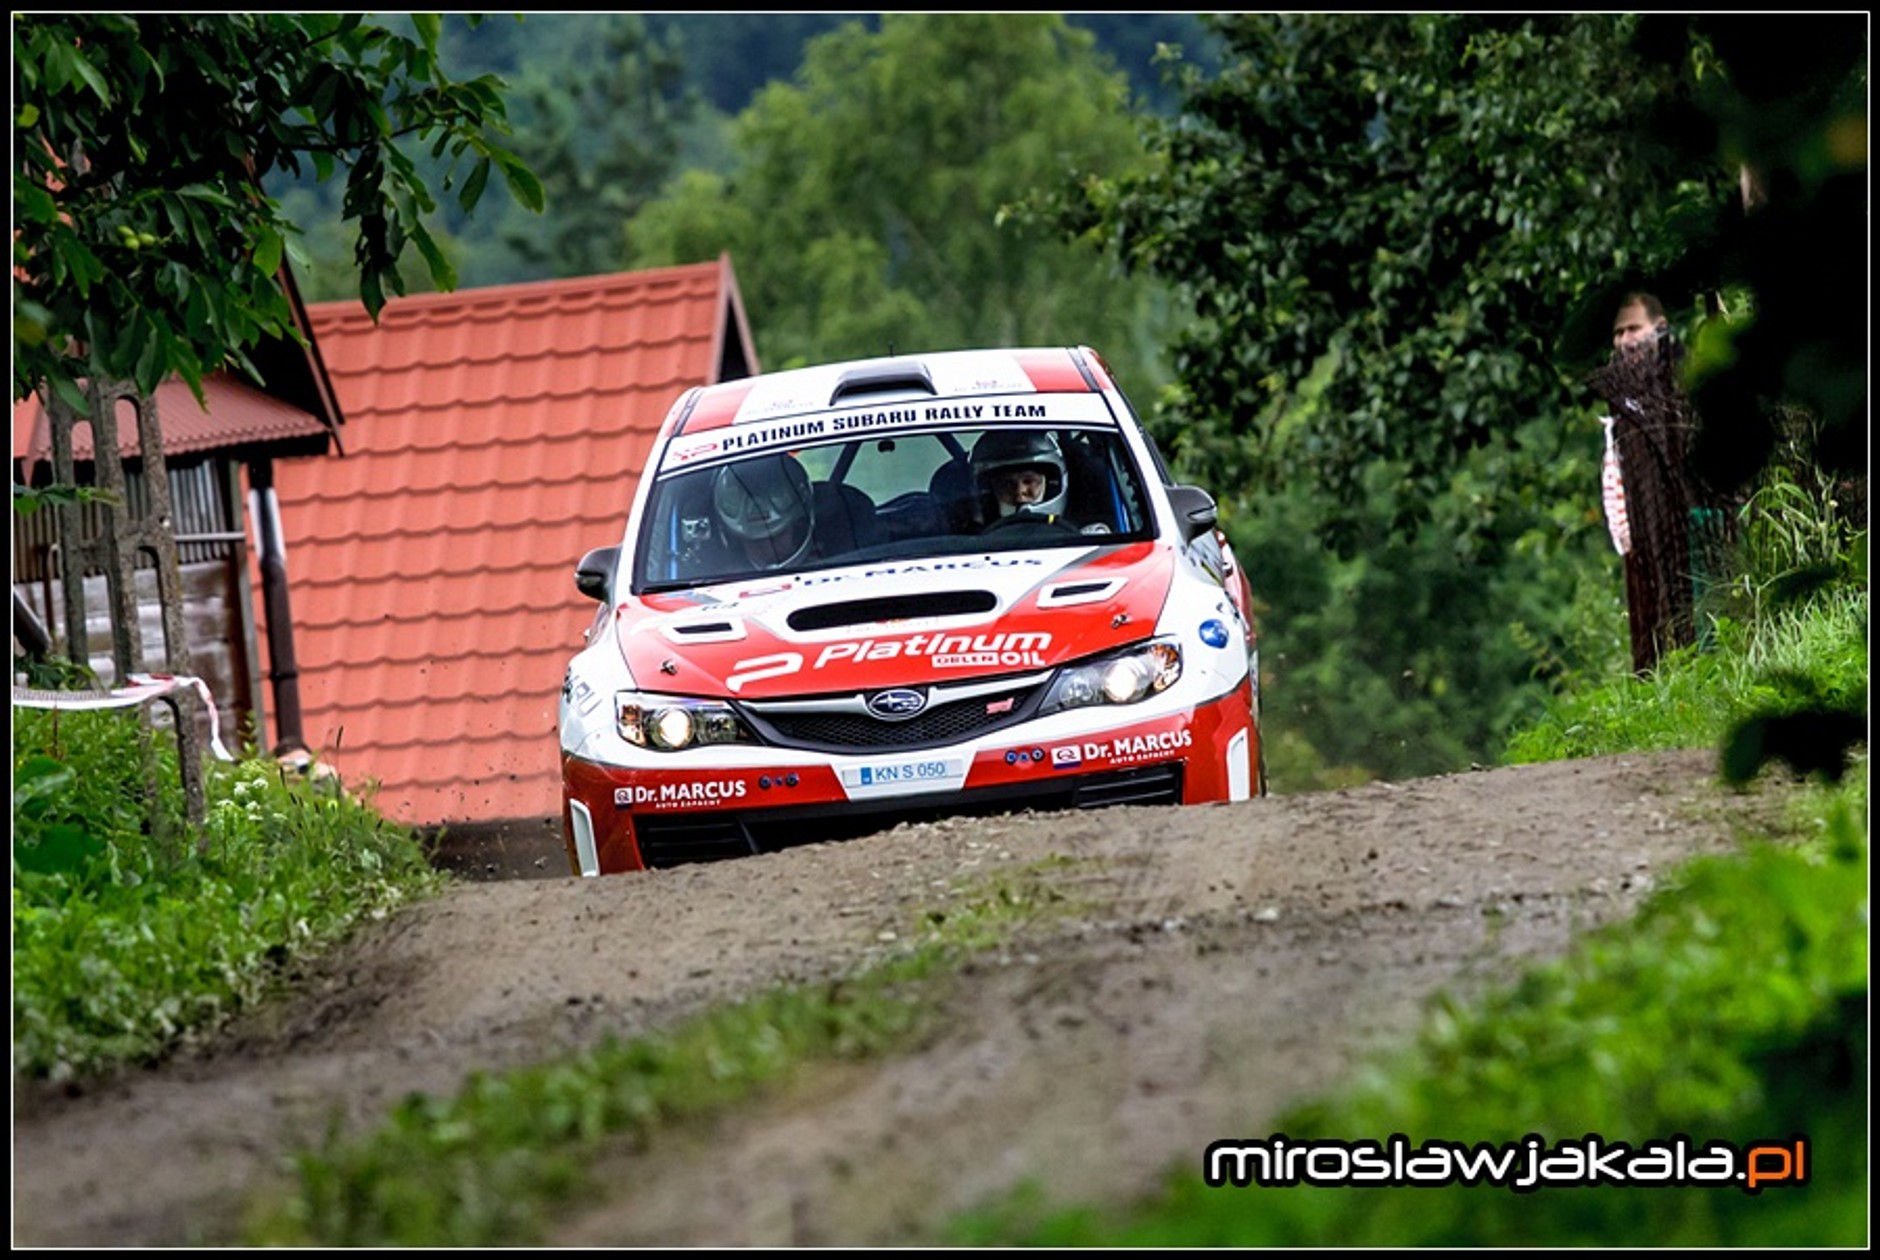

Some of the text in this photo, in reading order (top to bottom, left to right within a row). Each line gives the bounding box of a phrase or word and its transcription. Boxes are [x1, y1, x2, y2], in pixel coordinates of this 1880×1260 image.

[722, 404, 1047, 451] PLATINUM SUBARU RALLY TEAM
[864, 559, 1042, 578] MARCUS
[813, 632, 1053, 670] Platinum
[1000, 651, 1046, 667] OIL
[1083, 729, 1192, 760] Dr. MARCUS
[874, 761, 946, 781] KN S 050
[634, 779, 747, 803] Dr. MARCUS
